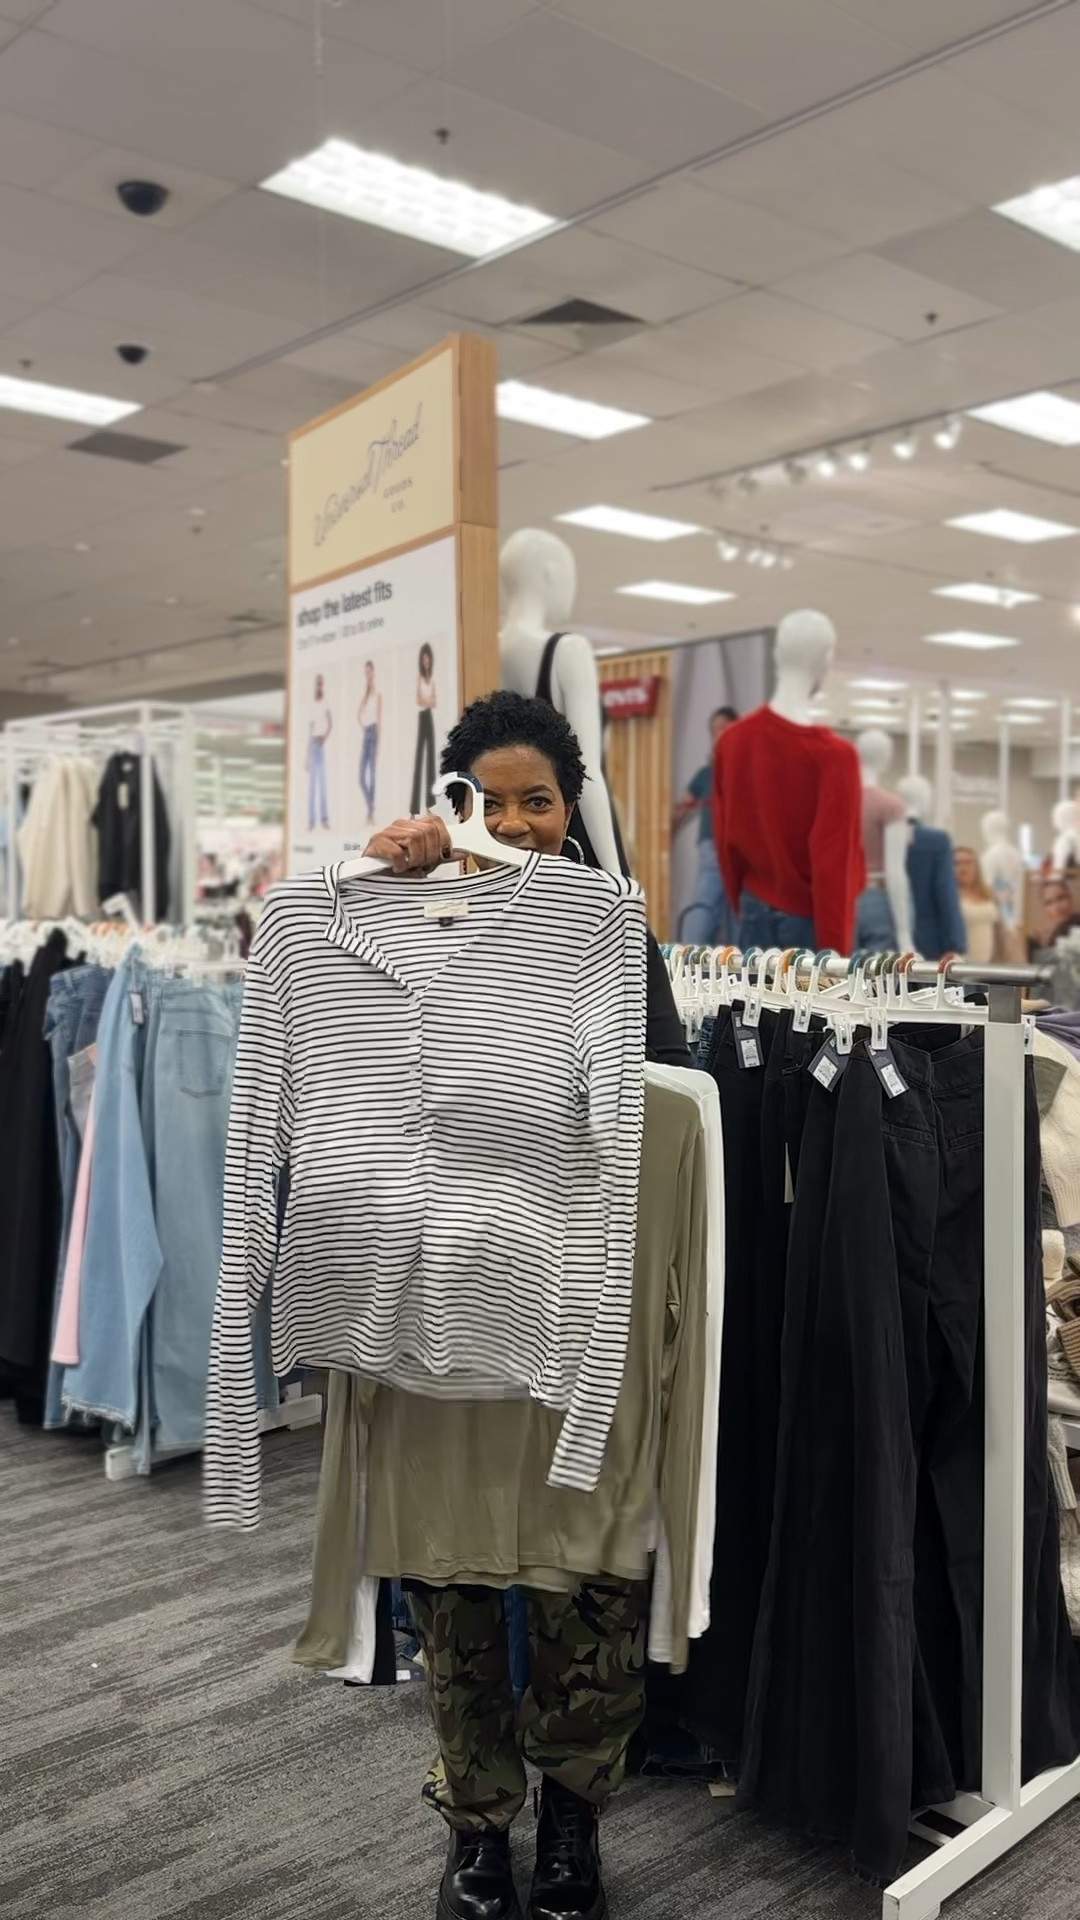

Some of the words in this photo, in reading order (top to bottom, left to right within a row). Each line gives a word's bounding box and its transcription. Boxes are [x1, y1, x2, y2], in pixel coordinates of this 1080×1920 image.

[367, 401, 423, 494] Thread
[383, 476, 413, 498] GOODS
[297, 606, 323, 628] shop
[323, 599, 341, 619] the
[341, 585, 372, 612] latest
[373, 580, 393, 602] fits
